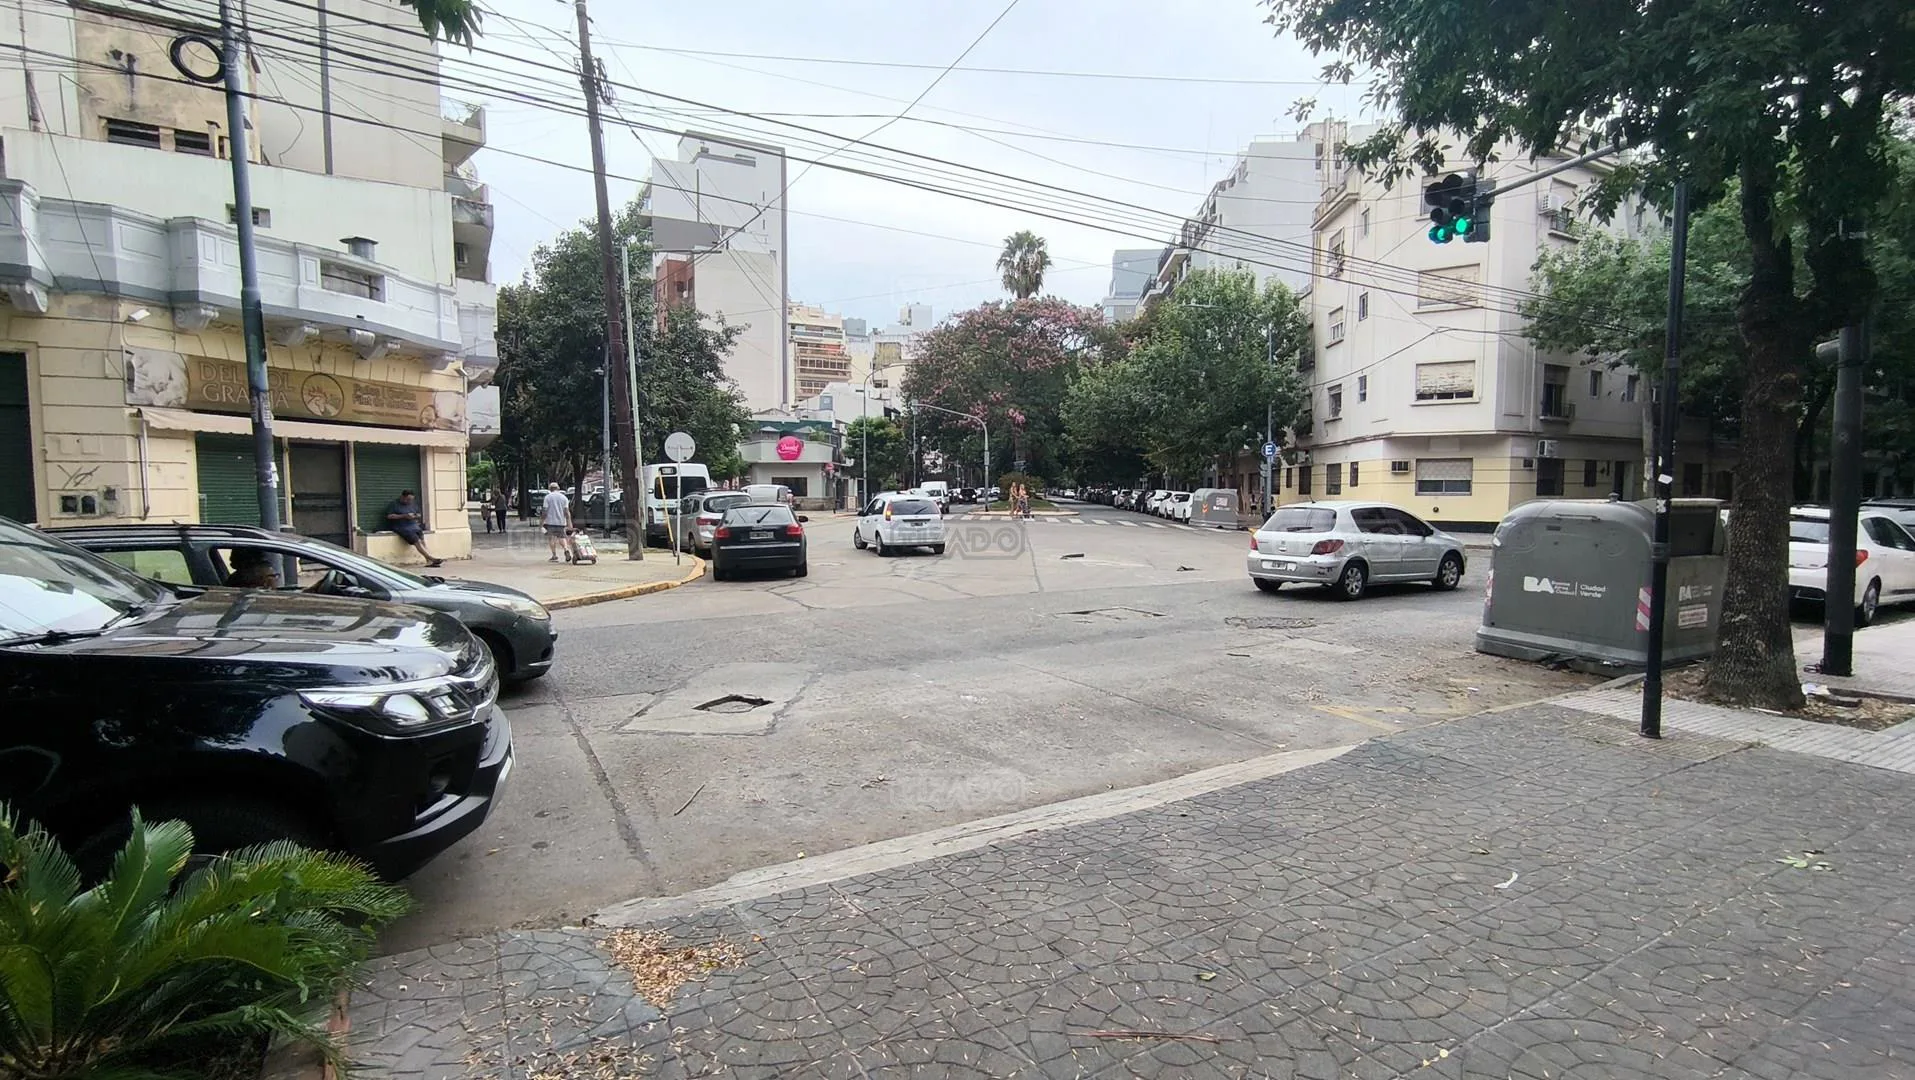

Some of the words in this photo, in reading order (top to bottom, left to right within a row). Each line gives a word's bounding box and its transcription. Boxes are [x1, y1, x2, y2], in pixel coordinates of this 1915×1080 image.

[199, 360, 243, 385] DEL
[202, 383, 290, 410] GRAJA
[1265, 444, 1273, 455] E
[1523, 576, 1554, 593] BA
[1580, 584, 1606, 592] Ciudad
[1580, 590, 1602, 598] Verde
